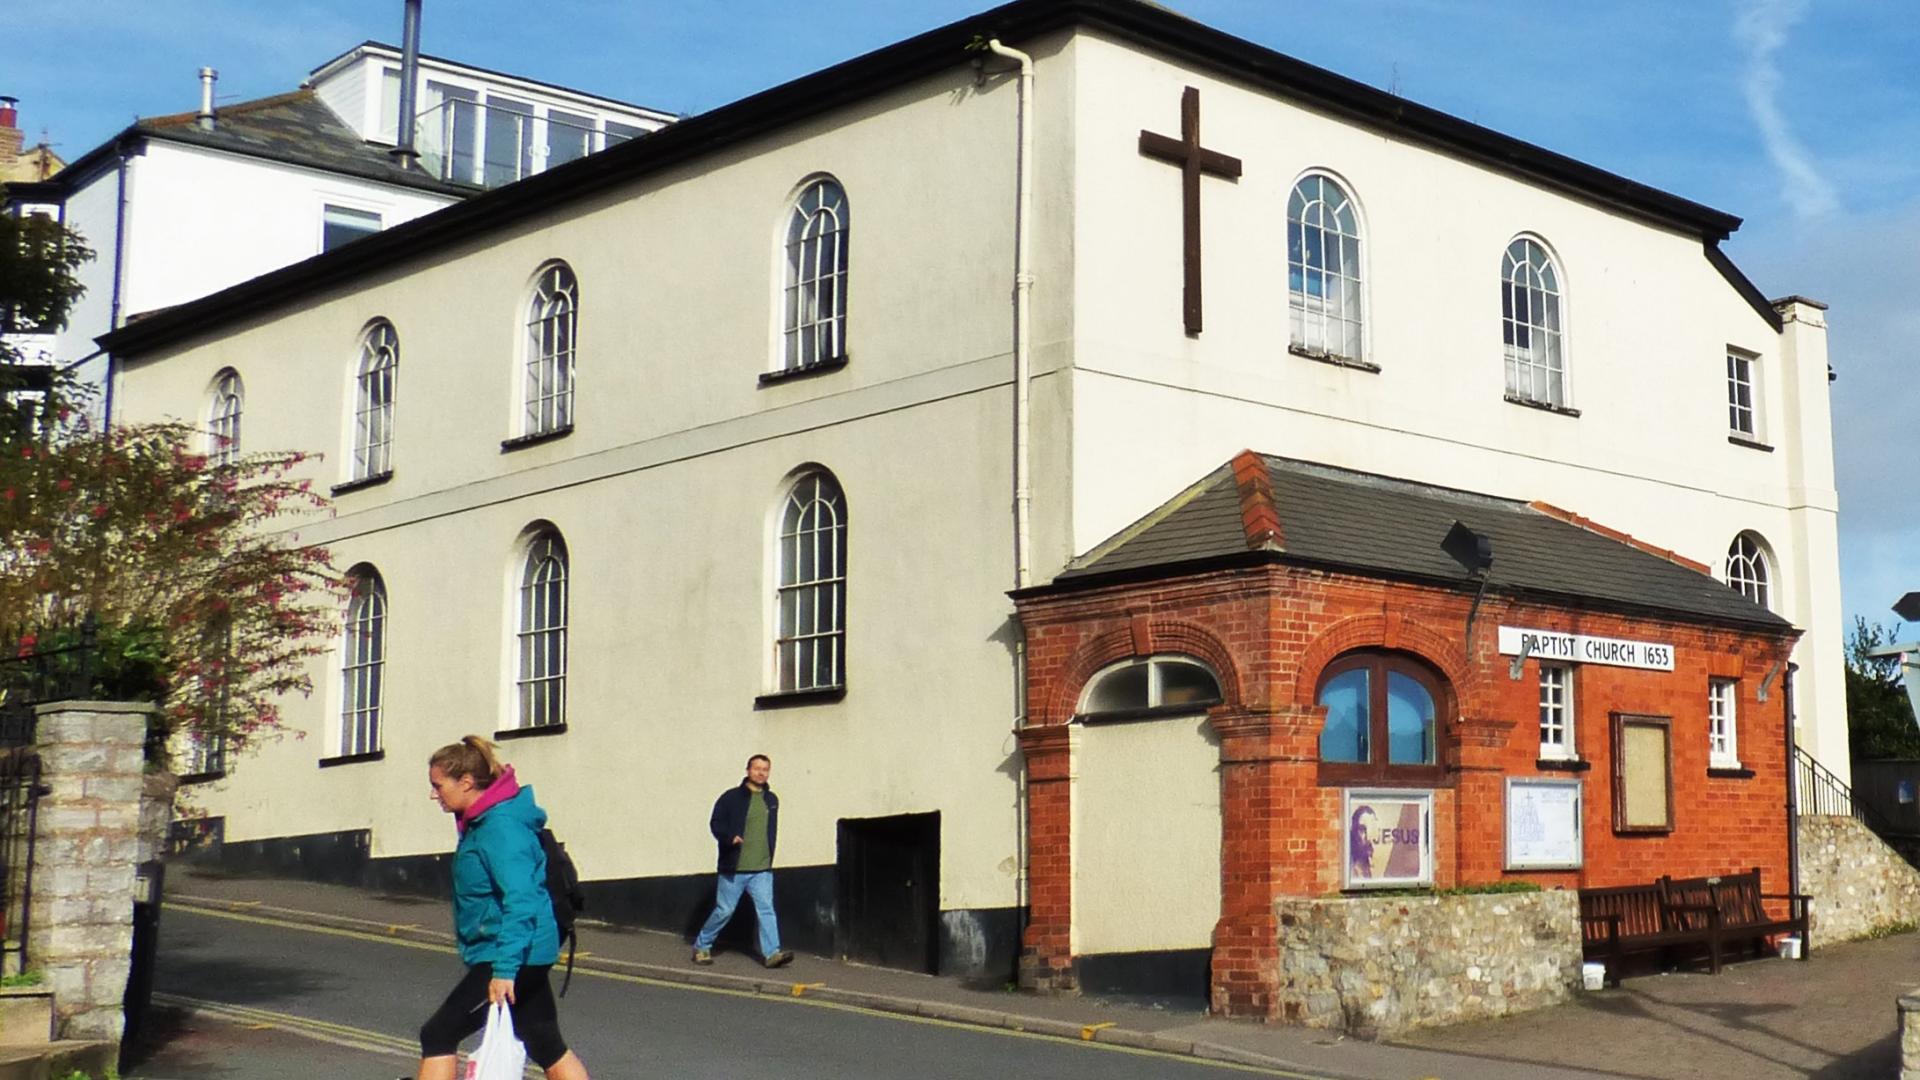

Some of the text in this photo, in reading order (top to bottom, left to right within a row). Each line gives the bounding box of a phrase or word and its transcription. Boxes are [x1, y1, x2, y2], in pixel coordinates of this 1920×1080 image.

[1586, 640, 1635, 663] CHURCH
[1644, 645, 1669, 666] 1653
[1373, 828, 1420, 845] JESUS
